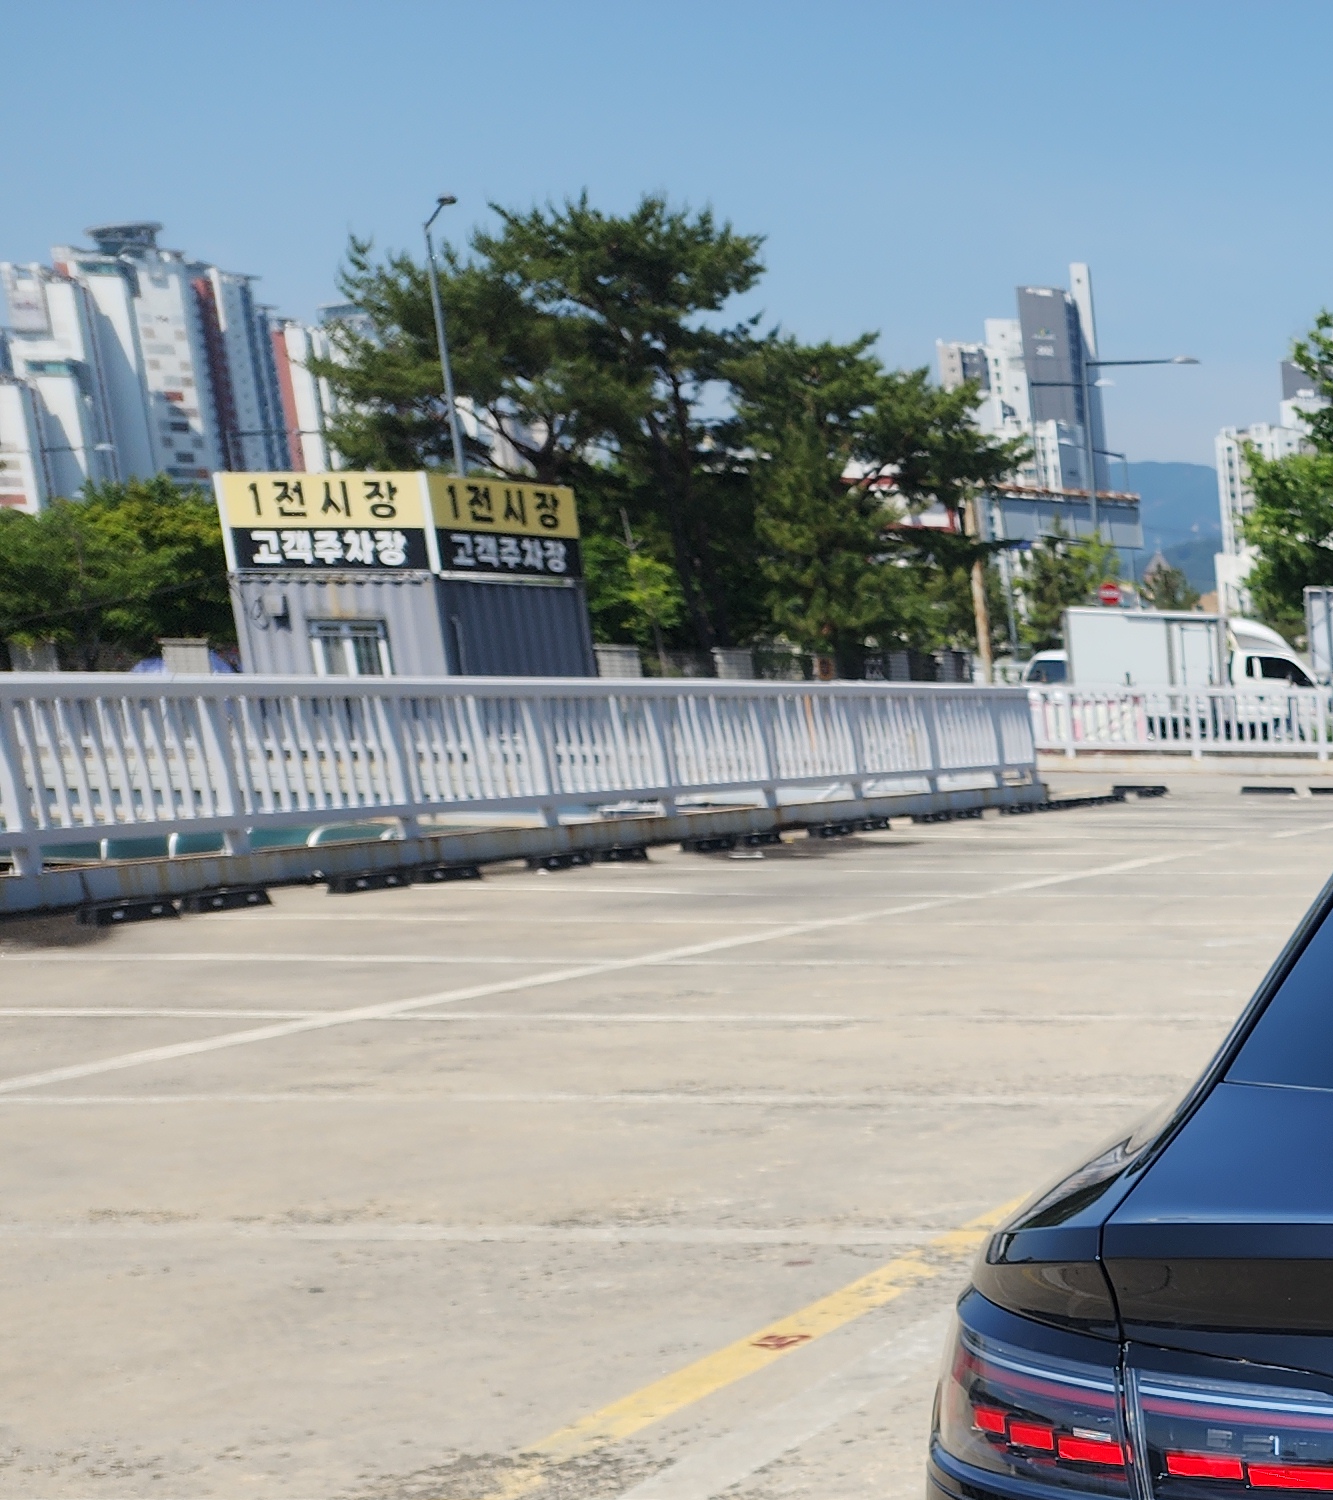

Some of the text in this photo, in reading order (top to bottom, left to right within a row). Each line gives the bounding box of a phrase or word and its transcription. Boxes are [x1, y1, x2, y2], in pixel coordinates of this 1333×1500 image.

[248, 480, 399, 520] 1전시장
[446, 484, 560, 530] 1전시장
[250, 530, 408, 566] 고객주차장
[451, 533, 567, 574] 고객주차장
